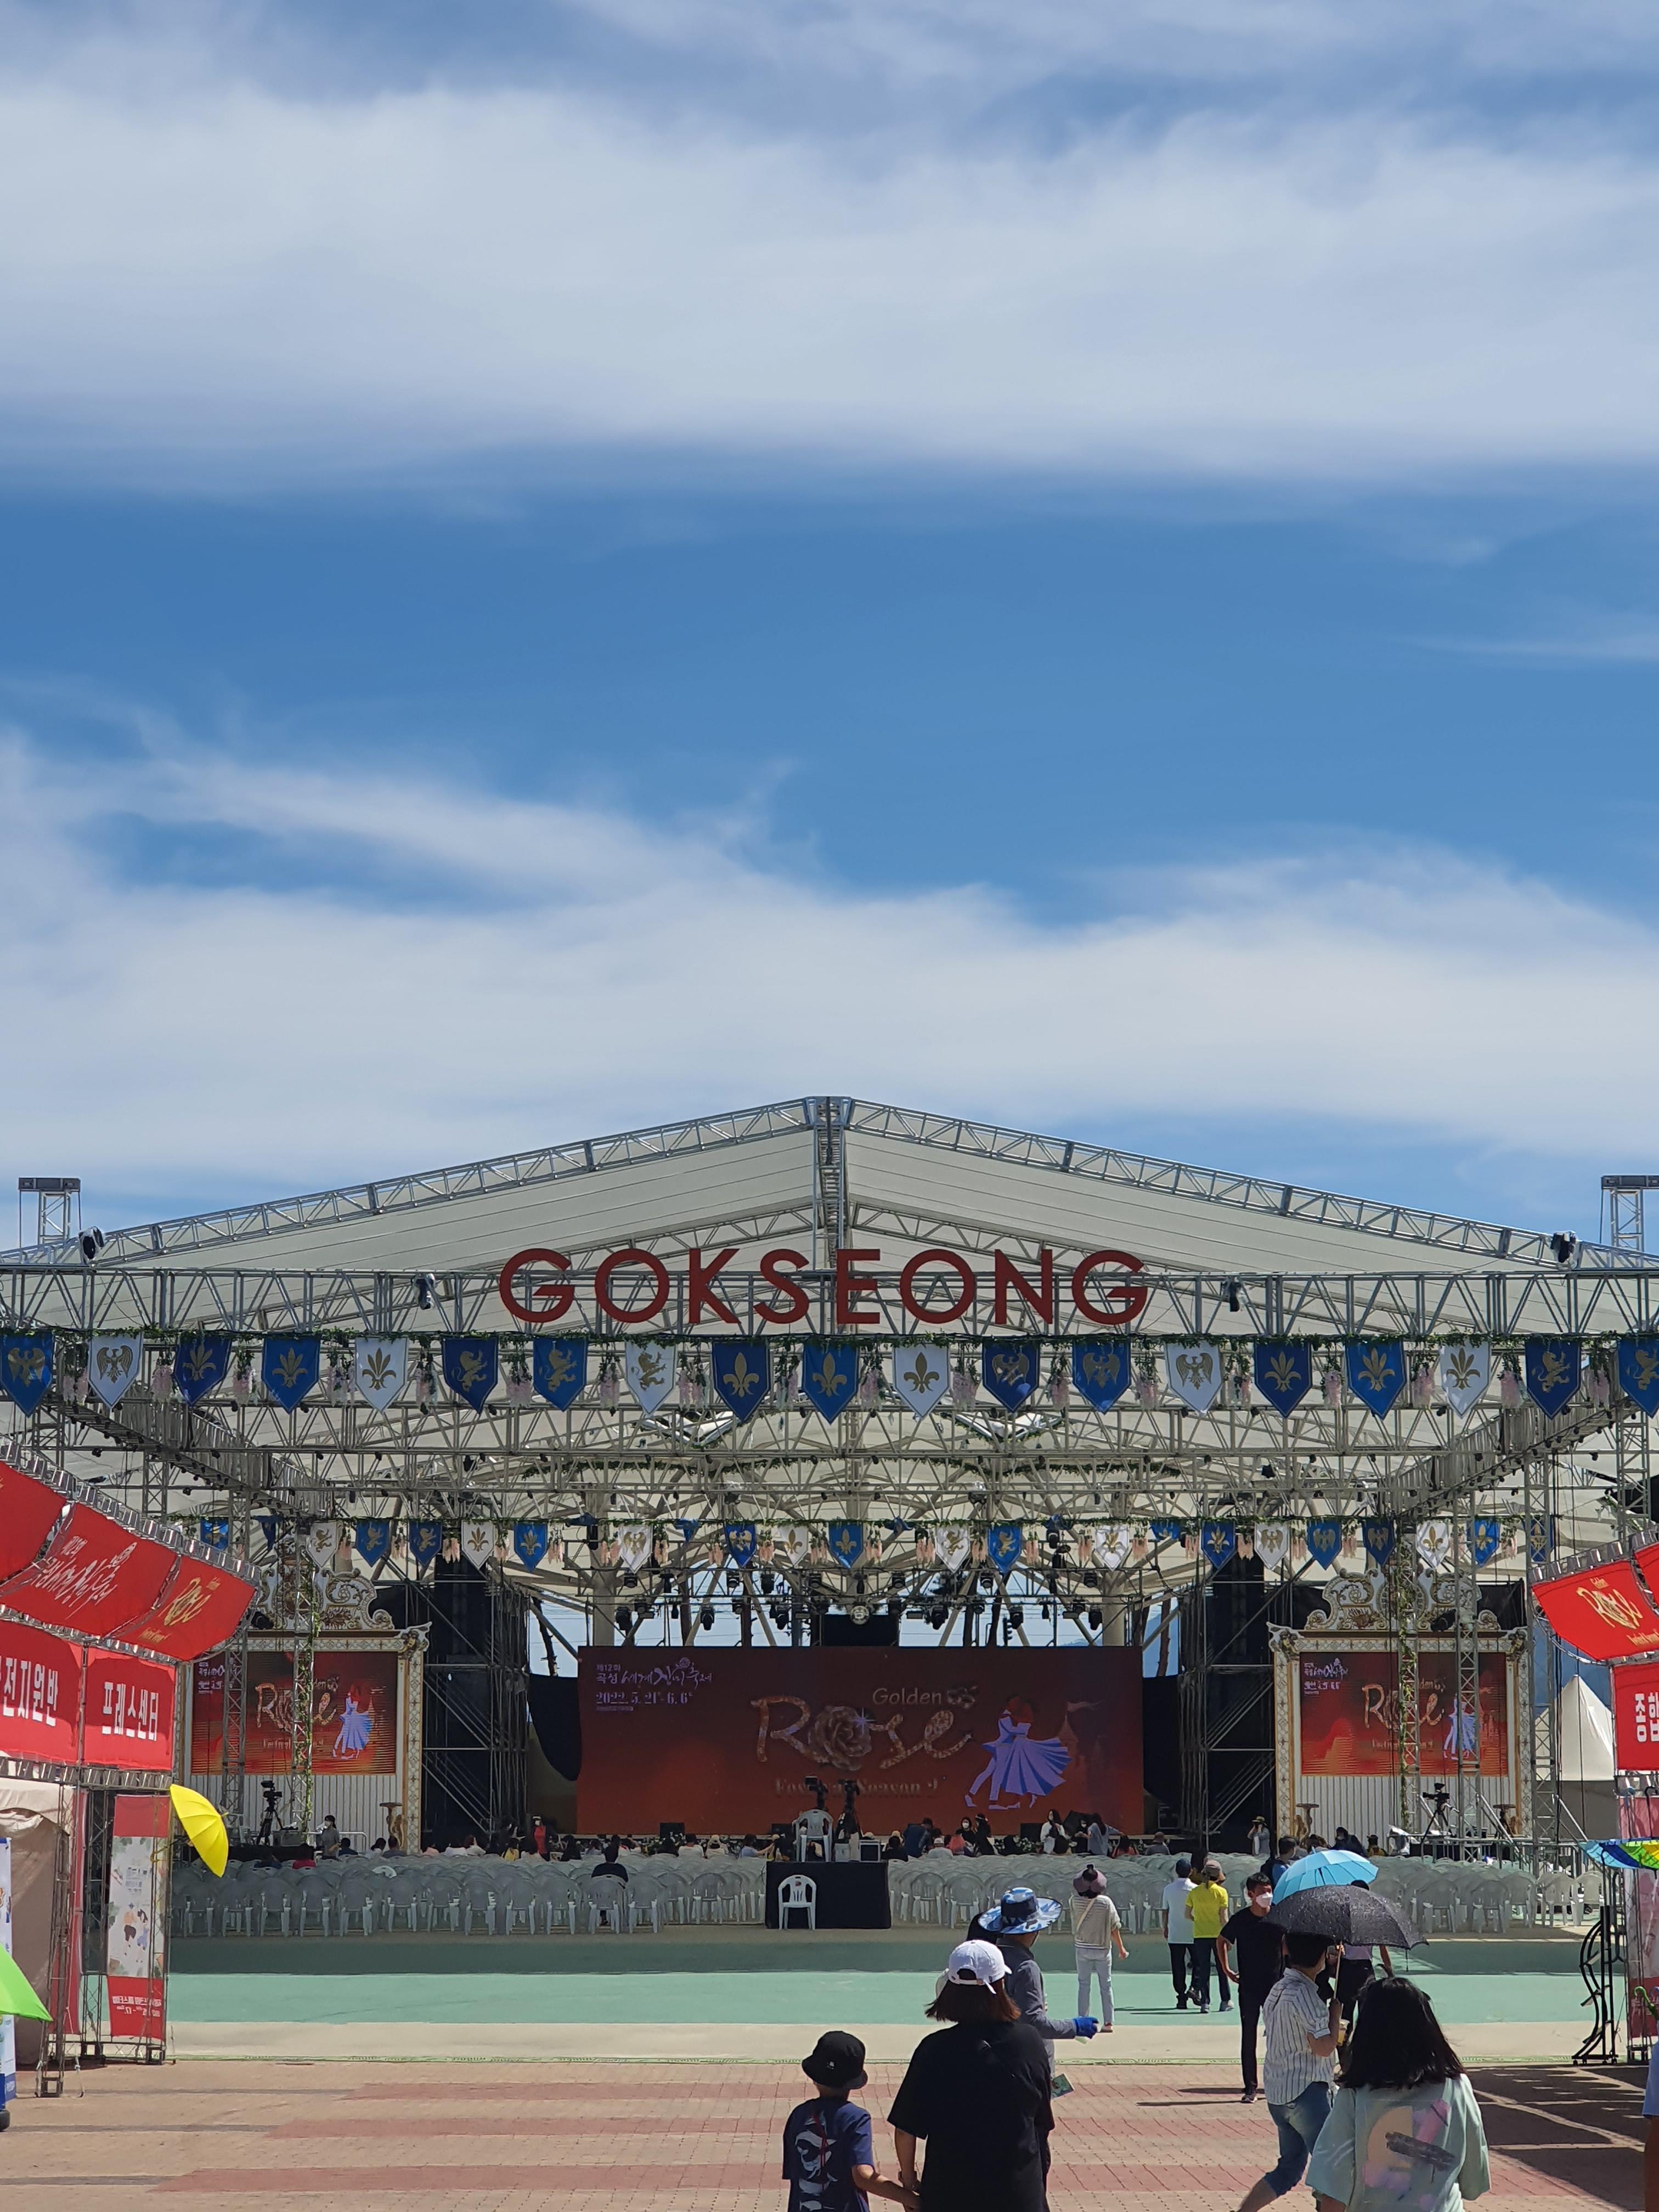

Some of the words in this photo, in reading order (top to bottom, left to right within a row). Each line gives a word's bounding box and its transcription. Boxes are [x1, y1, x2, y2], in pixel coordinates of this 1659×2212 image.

[499, 1248, 1148, 1324] GOKSEONG
[0, 1656, 58, 1727] 전지원반
[102, 1681, 159, 1741] 프레스센터
[596, 1673, 618, 1684] 곡성
[872, 1687, 941, 1706] Golden
[751, 1696, 972, 1771] Rose
